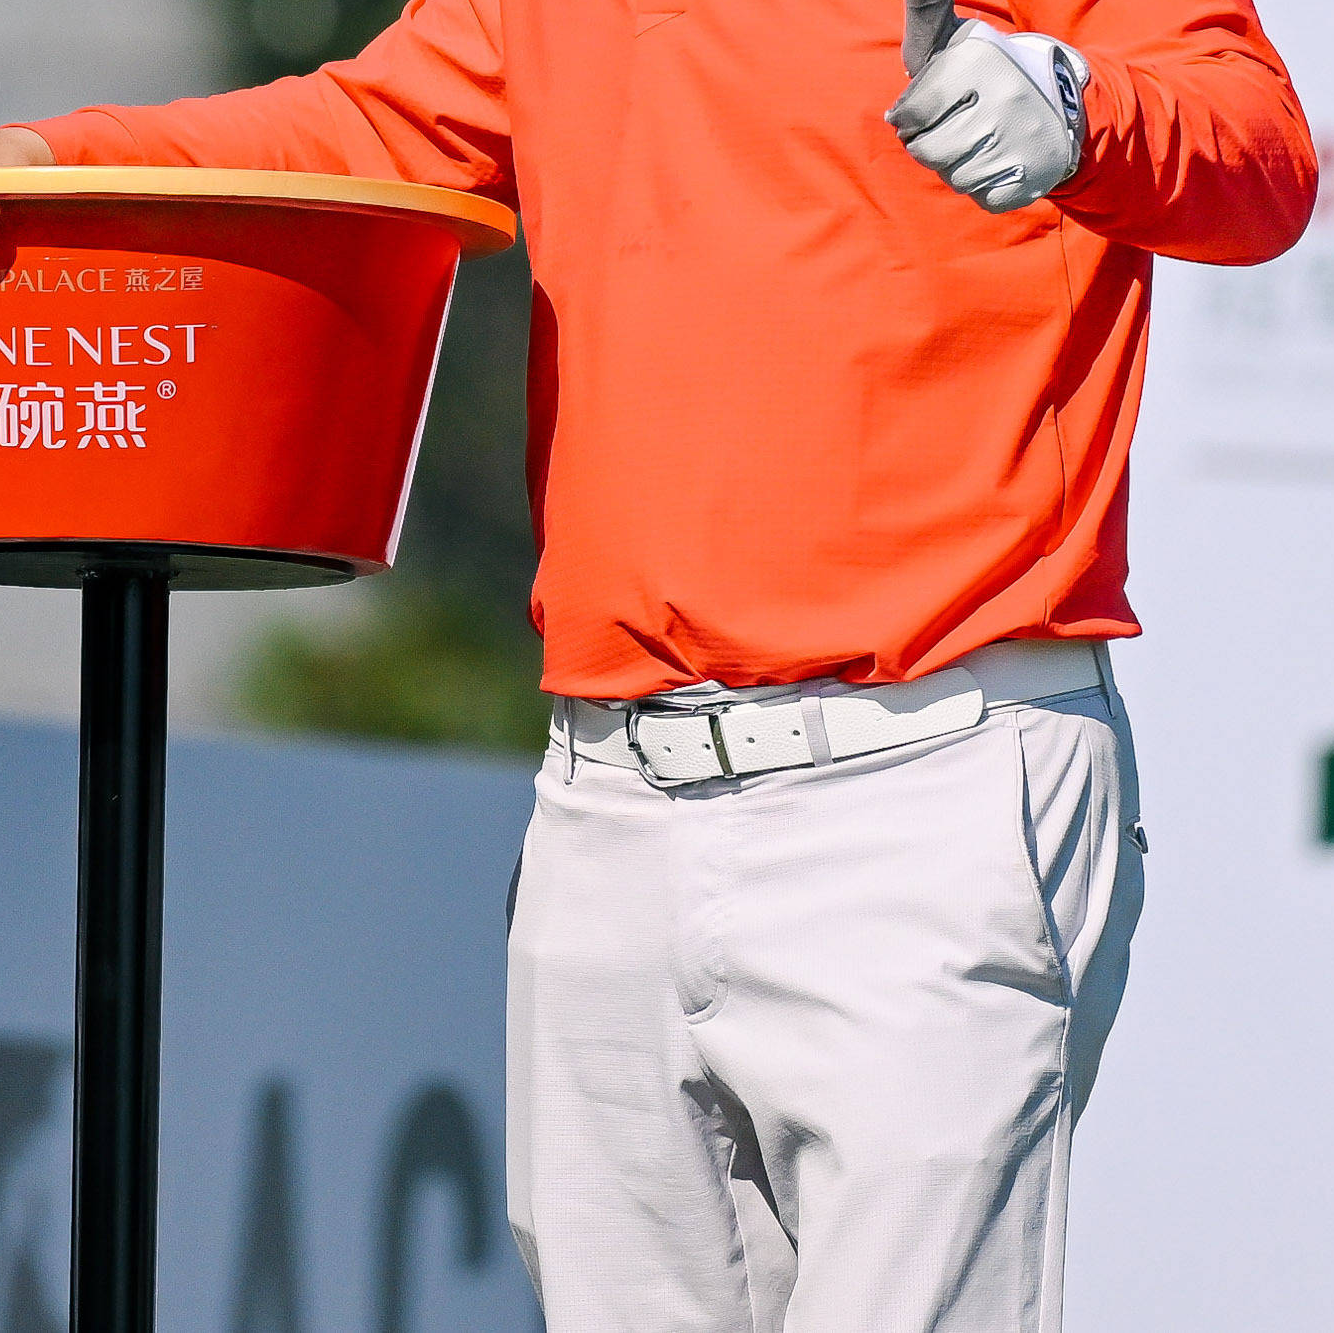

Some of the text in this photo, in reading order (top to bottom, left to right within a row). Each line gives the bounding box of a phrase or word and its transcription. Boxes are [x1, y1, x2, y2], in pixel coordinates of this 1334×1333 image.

[0, 268, 117, 293] PALACE
[124, 266, 205, 292] 燕之屋
[66, 323, 208, 367] NEST
